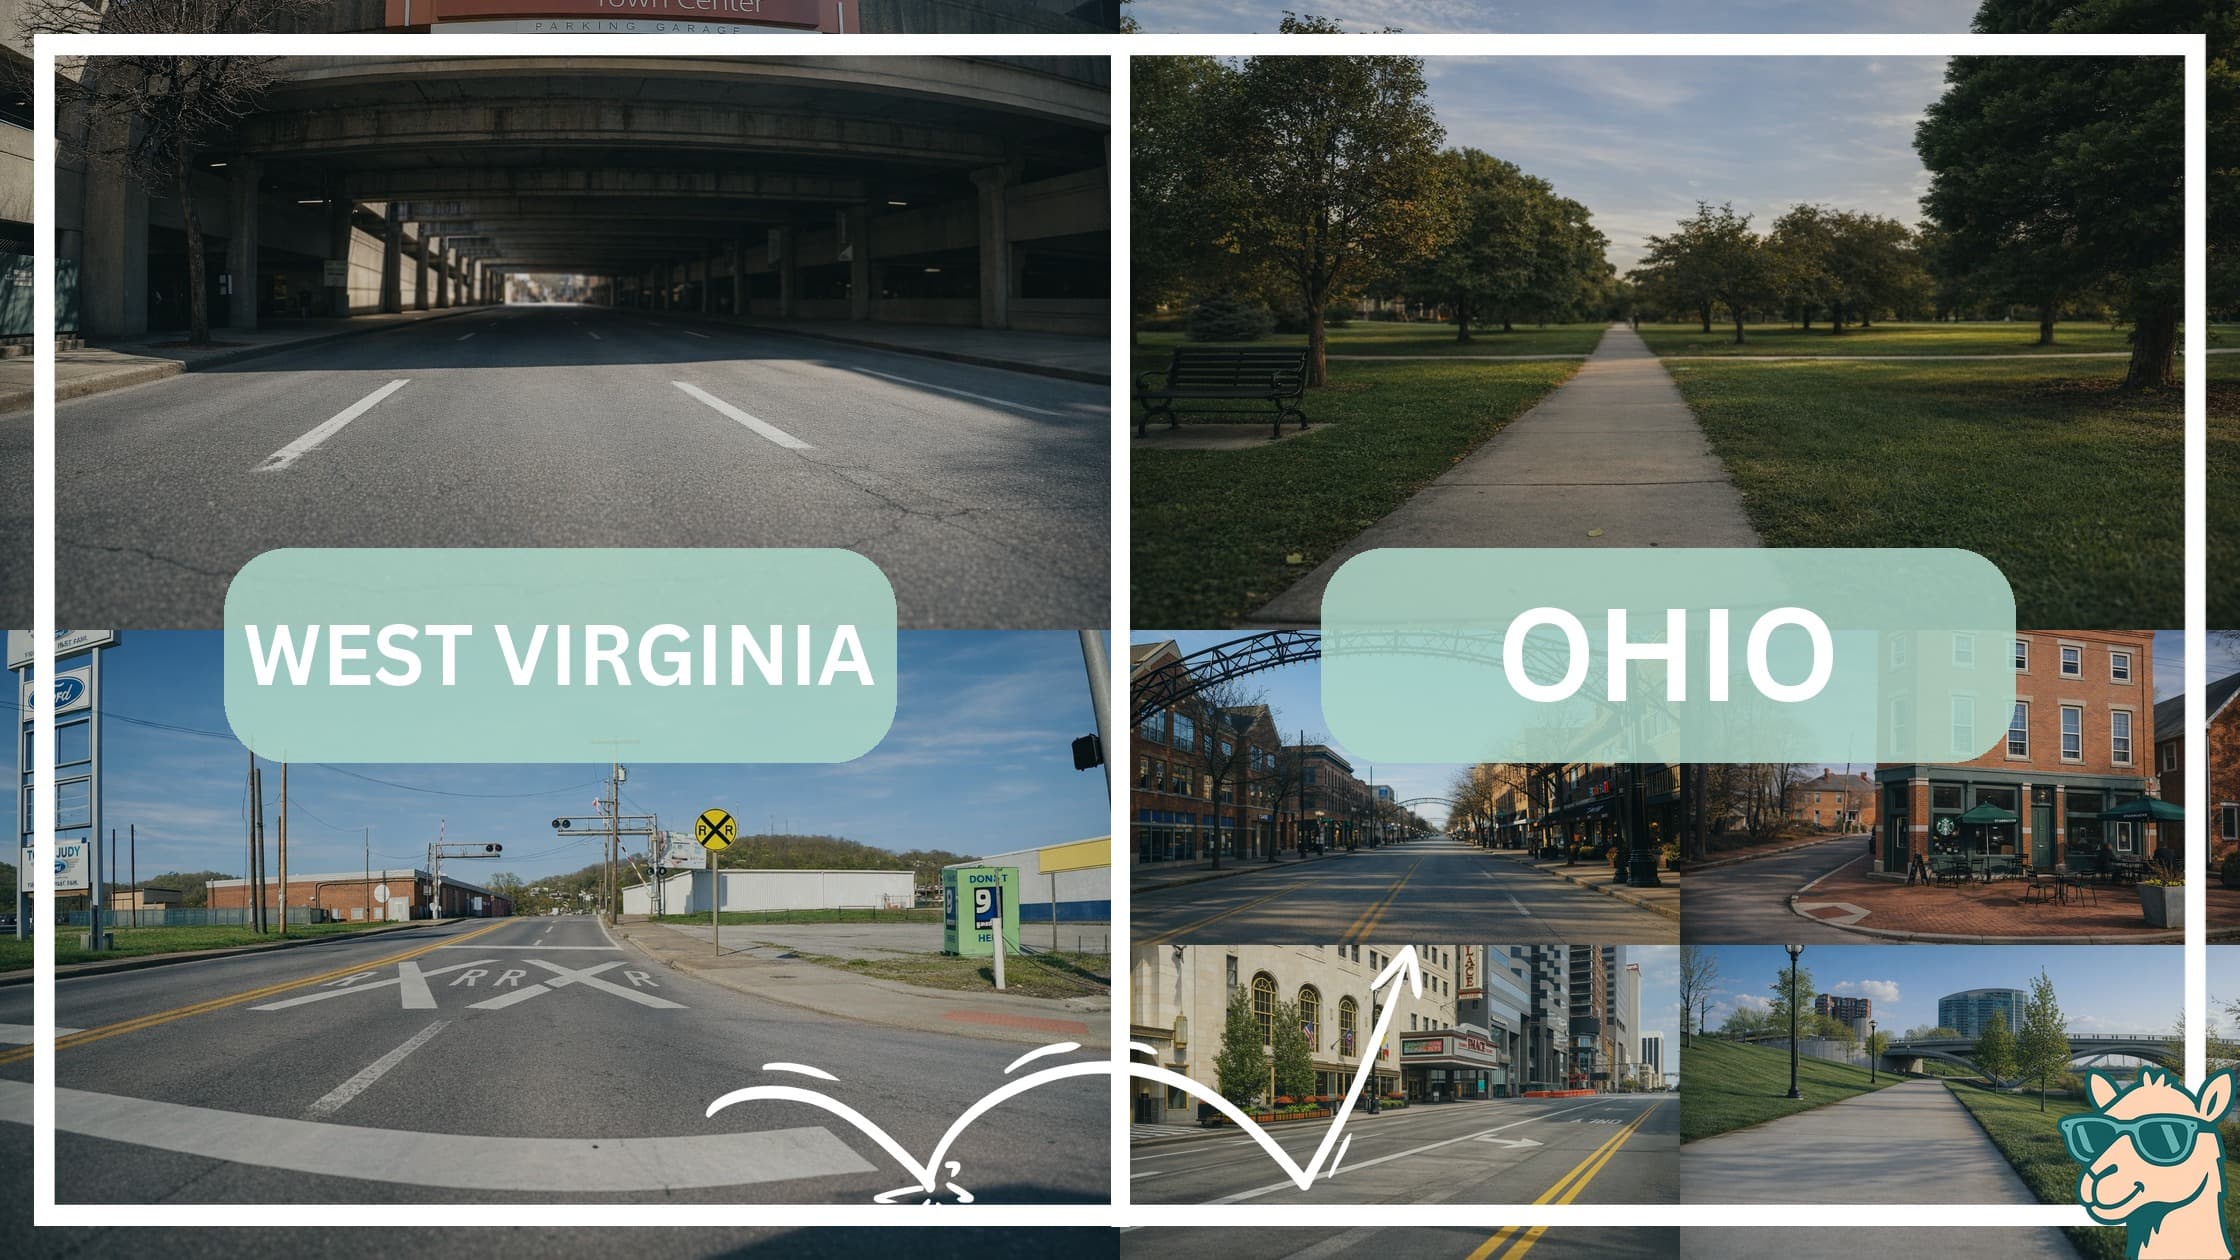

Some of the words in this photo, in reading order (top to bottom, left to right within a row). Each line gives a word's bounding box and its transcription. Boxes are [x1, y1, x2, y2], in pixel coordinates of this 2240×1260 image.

[678, 0, 761, 12] Center
[535, 21, 636, 31] PARKING
[56, 846, 80, 858] JUDY
[969, 874, 1008, 884] DONT
[623, 970, 660, 987] R
